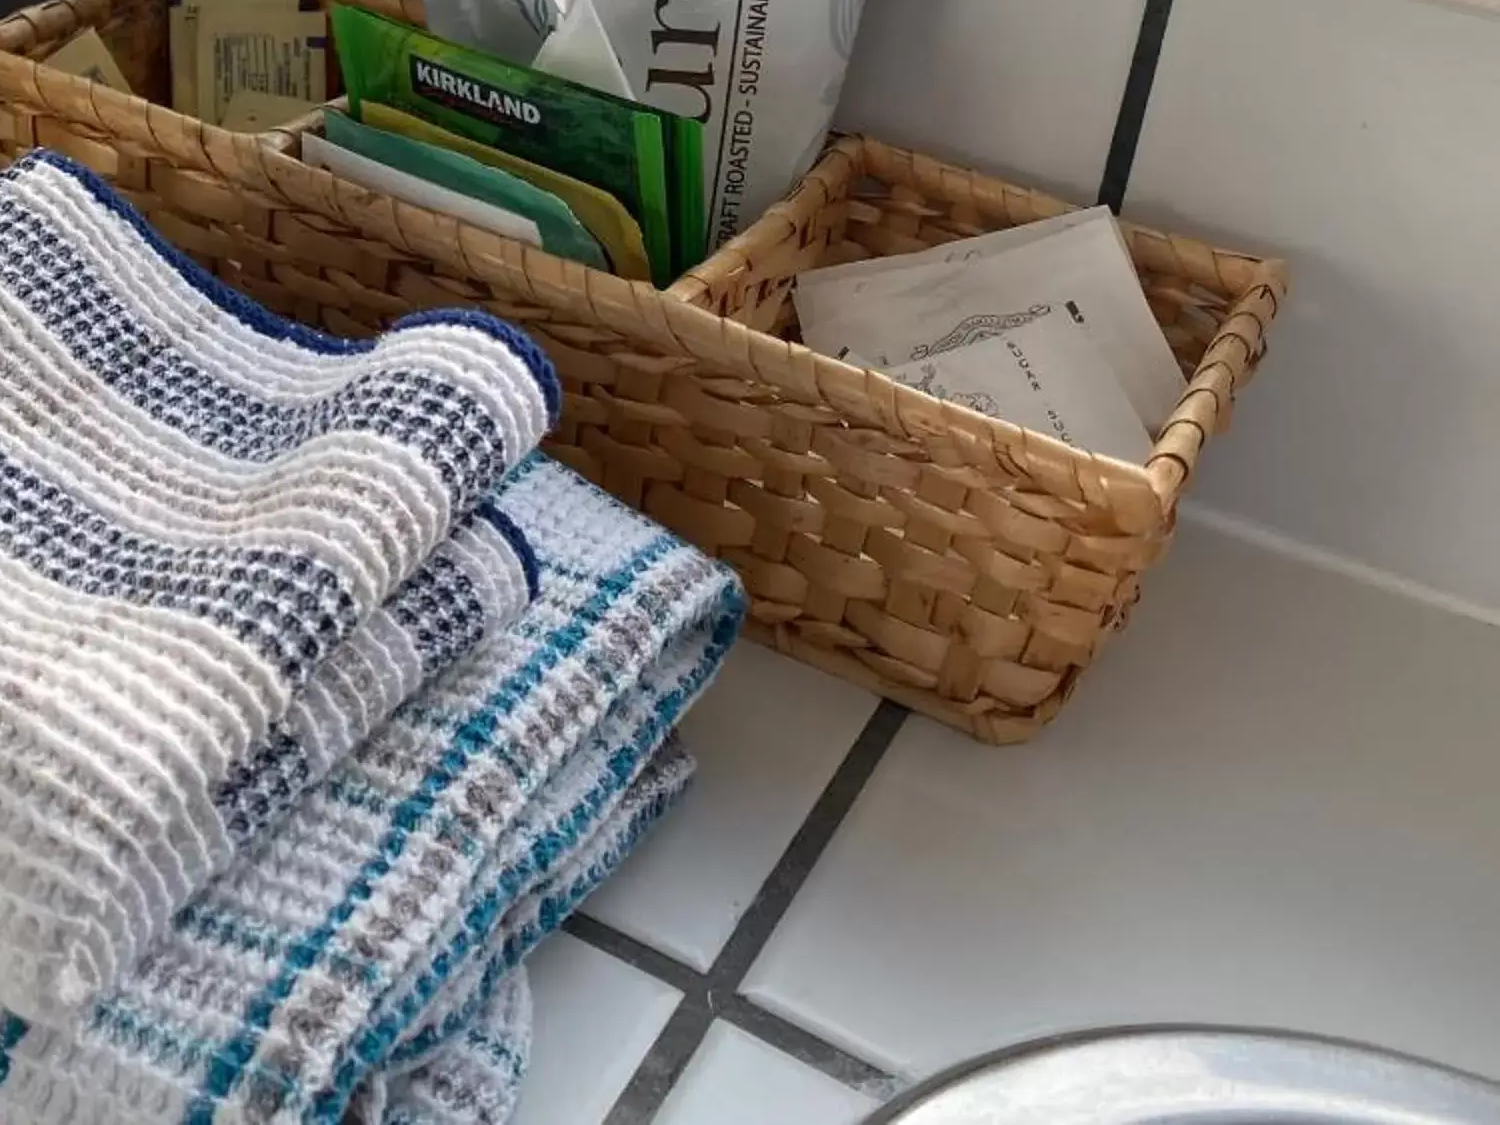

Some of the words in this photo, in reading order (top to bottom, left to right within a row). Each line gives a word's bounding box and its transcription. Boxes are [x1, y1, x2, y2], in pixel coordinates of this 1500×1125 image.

[416, 61, 542, 125] KIRKLAND
[725, 111, 754, 195] ROASTED
[716, 197, 741, 249] RAFT
